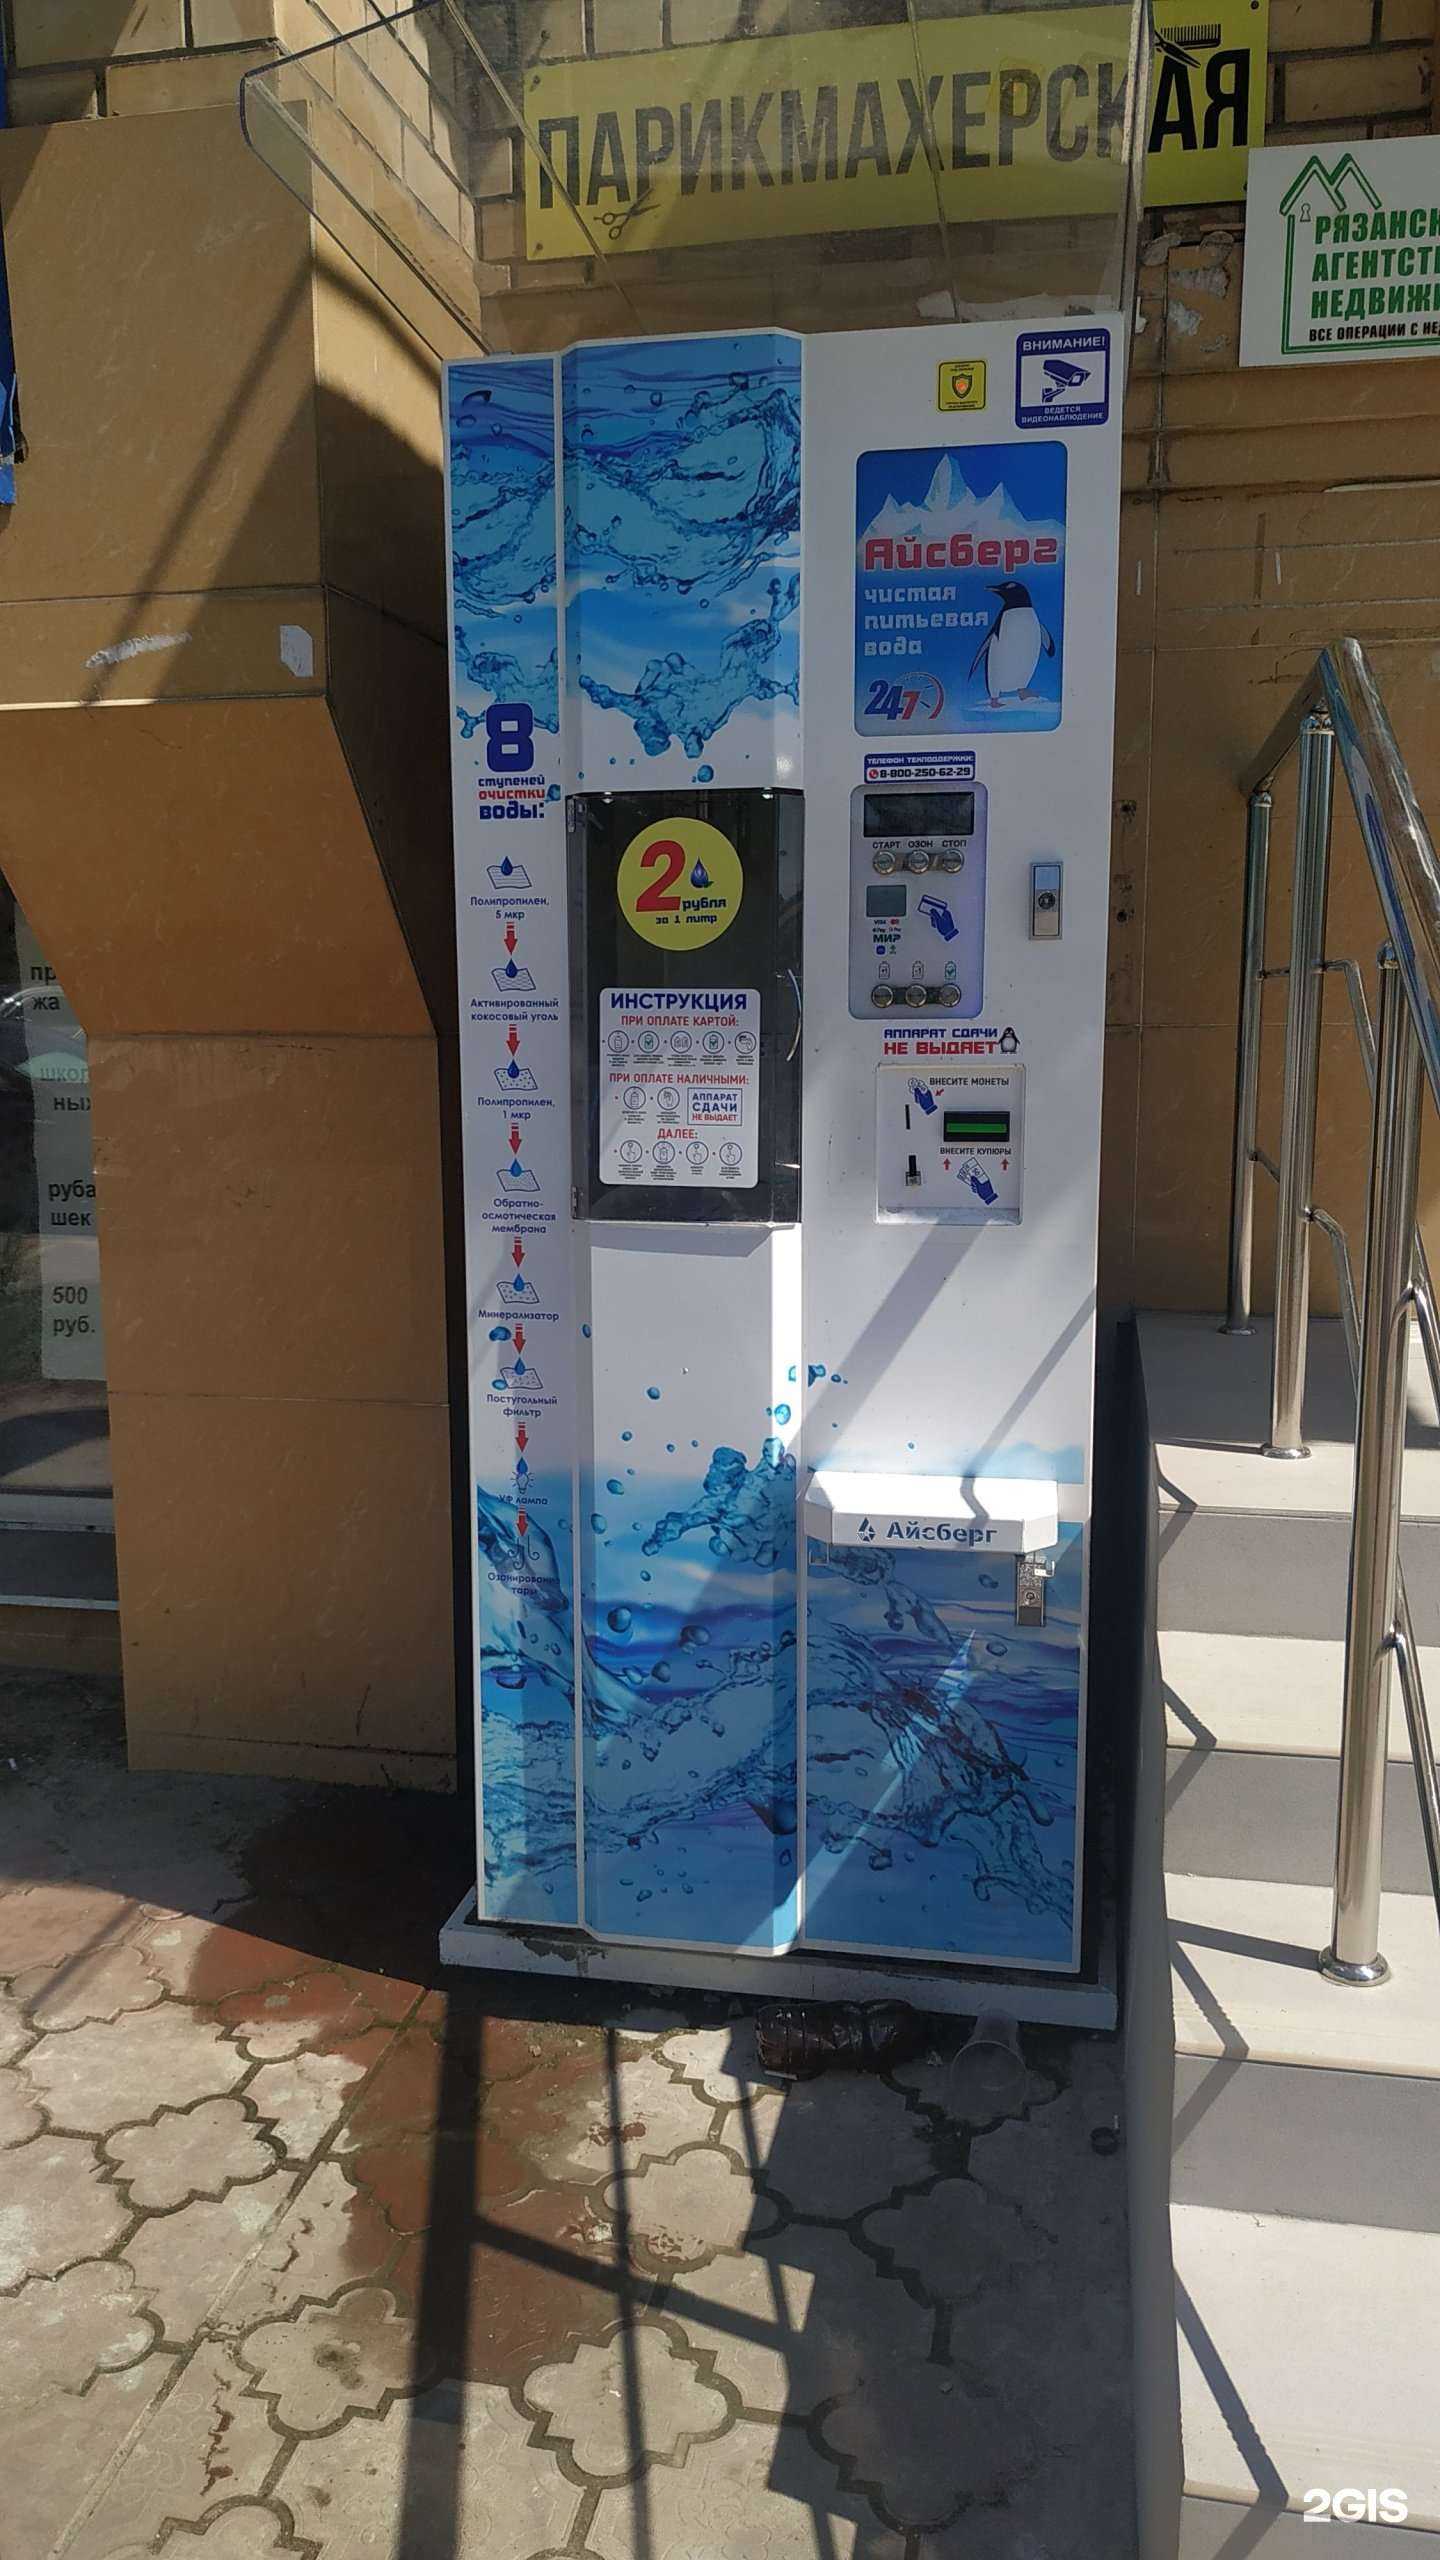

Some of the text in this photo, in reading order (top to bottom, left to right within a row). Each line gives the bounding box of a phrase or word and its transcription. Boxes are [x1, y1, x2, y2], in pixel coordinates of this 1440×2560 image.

[538, 48, 1250, 210] ПАРИКМАХЕРСКАЯ
[1309, 321, 1440, 342] ВСЕ ОПЕРАЦИИ С НЕ
[1022, 335, 1105, 352] ВНИМАНИЕ!
[1044, 406, 1081, 414] ВЕДЕТСЯ
[1021, 412, 1103, 424] ВИДЕОНАБЛЮДЕНИЕ
[864, 534, 1058, 573] Айсберг
[864, 585, 957, 603] чистая
[864, 611, 989, 630] питьевая
[864, 636, 923, 656] вода
[485, 702, 534, 773] 8
[867, 757, 905, 765] ТЕЛЕФОН
[880, 767, 971, 779] 8-800-250-62-29
[478, 774, 545, 788] ступеней
[478, 789, 545, 800] очистки
[480, 800, 545, 819] воды:
[872, 841, 901, 849] СТАРТ
[908, 840, 933, 848] ОЗОН
[942, 839, 967, 848] СТОП
[635, 839, 727, 912] 2 рубля
[470, 896, 550, 908] Полипропилен,
[495, 911, 525, 921] 5 мкр
[655, 915, 717, 924] за 1 литр
[873, 933, 901, 943] МИР
[470, 998, 559, 1009] Активированный
[611, 993, 747, 1012] ИНСТРУКЦИЯ
[471, 1011, 559, 1022] кокосовый уголь
[621, 1014, 739, 1027] ПРИ ОПЛАТЕ КАРТОЙ:
[884, 1027, 998, 1039] АППАРАТ СДАЧИ
[884, 1040, 997, 1055] НЕ ВЫДАЕТ
[609, 1073, 749, 1085] ПРИ ОПЛАТЕ НАЛИЧНЫМИ:
[929, 1077, 1010, 1086] ВНЕСИТЕ МОНЕТЫ
[477, 1096, 555, 1108] Полипропилен,
[692, 1092, 738, 1101] АППАРАТ
[692, 1103, 738, 1113] СДАЧИ
[502, 1111, 531, 1121] 1 мкр
[704, 1114, 738, 1122] ВЫДАЕТ
[657, 1128, 698, 1139] ДАЛЕЕ:
[940, 1147, 1012, 1156] ВНЕСИТЕ КУПЮРЫ
[48, 1179, 96, 1201] руба
[493, 1198, 544, 1210] Обратно-
[51, 1211, 92, 1226] шек
[482, 1212, 556, 1221] осмотическая
[491, 1223, 547, 1234] мембрана
[52, 1286, 88, 1304] 500
[478, 1309, 559, 1322] Минерализатор
[53, 1315, 96, 1337] руб.
[486, 1393, 558, 1406] Постугольный
[503, 1408, 542, 1419] фильтр
[515, 1497, 549, 1505] лампа
[886, 1521, 998, 1547] Айсберг
